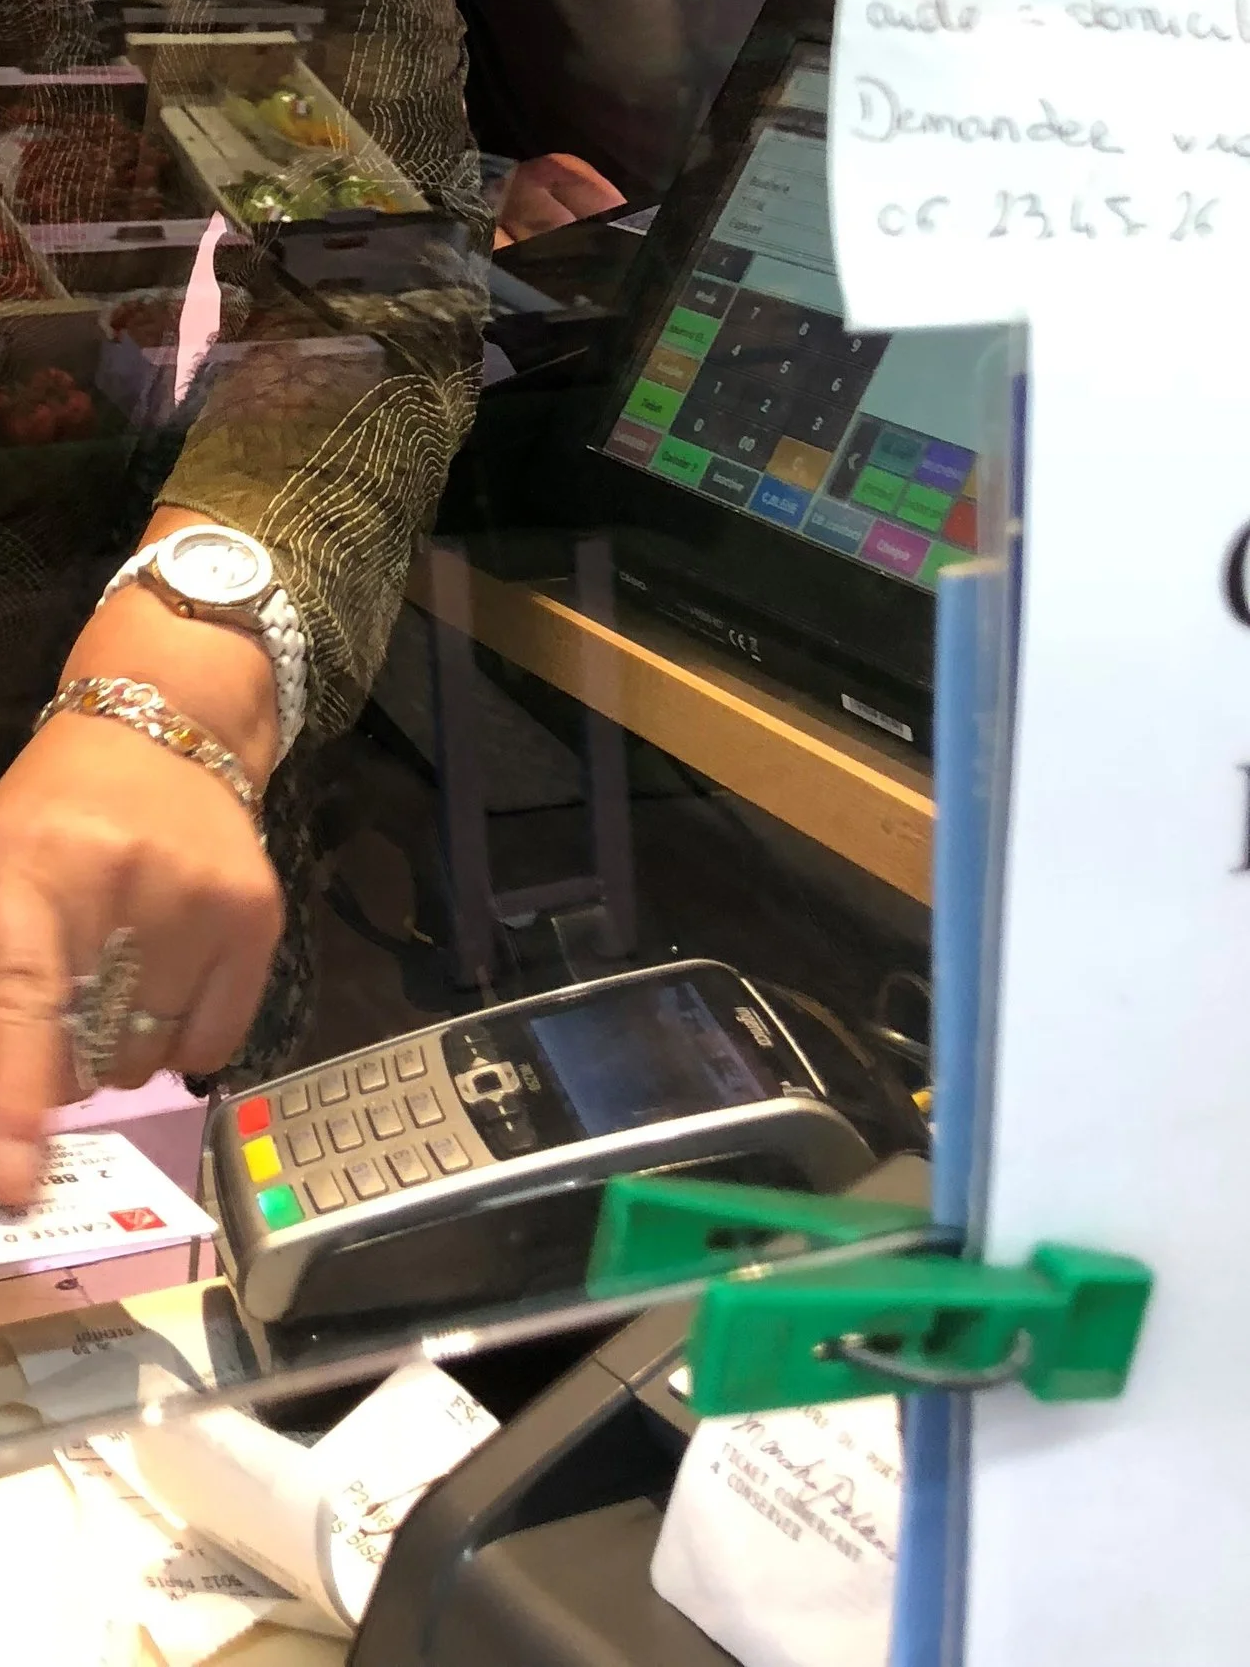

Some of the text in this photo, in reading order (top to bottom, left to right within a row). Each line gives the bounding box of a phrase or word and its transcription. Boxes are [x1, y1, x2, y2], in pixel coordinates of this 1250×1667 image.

[750, 306, 761, 320] 7
[850, 338, 862, 353] 9
[779, 360, 791, 373] 5
[831, 377, 842, 392] 6
[760, 399, 771, 414] 2
[812, 416, 823, 432] 3
[31, 1221, 112, 1242] CAISSE
